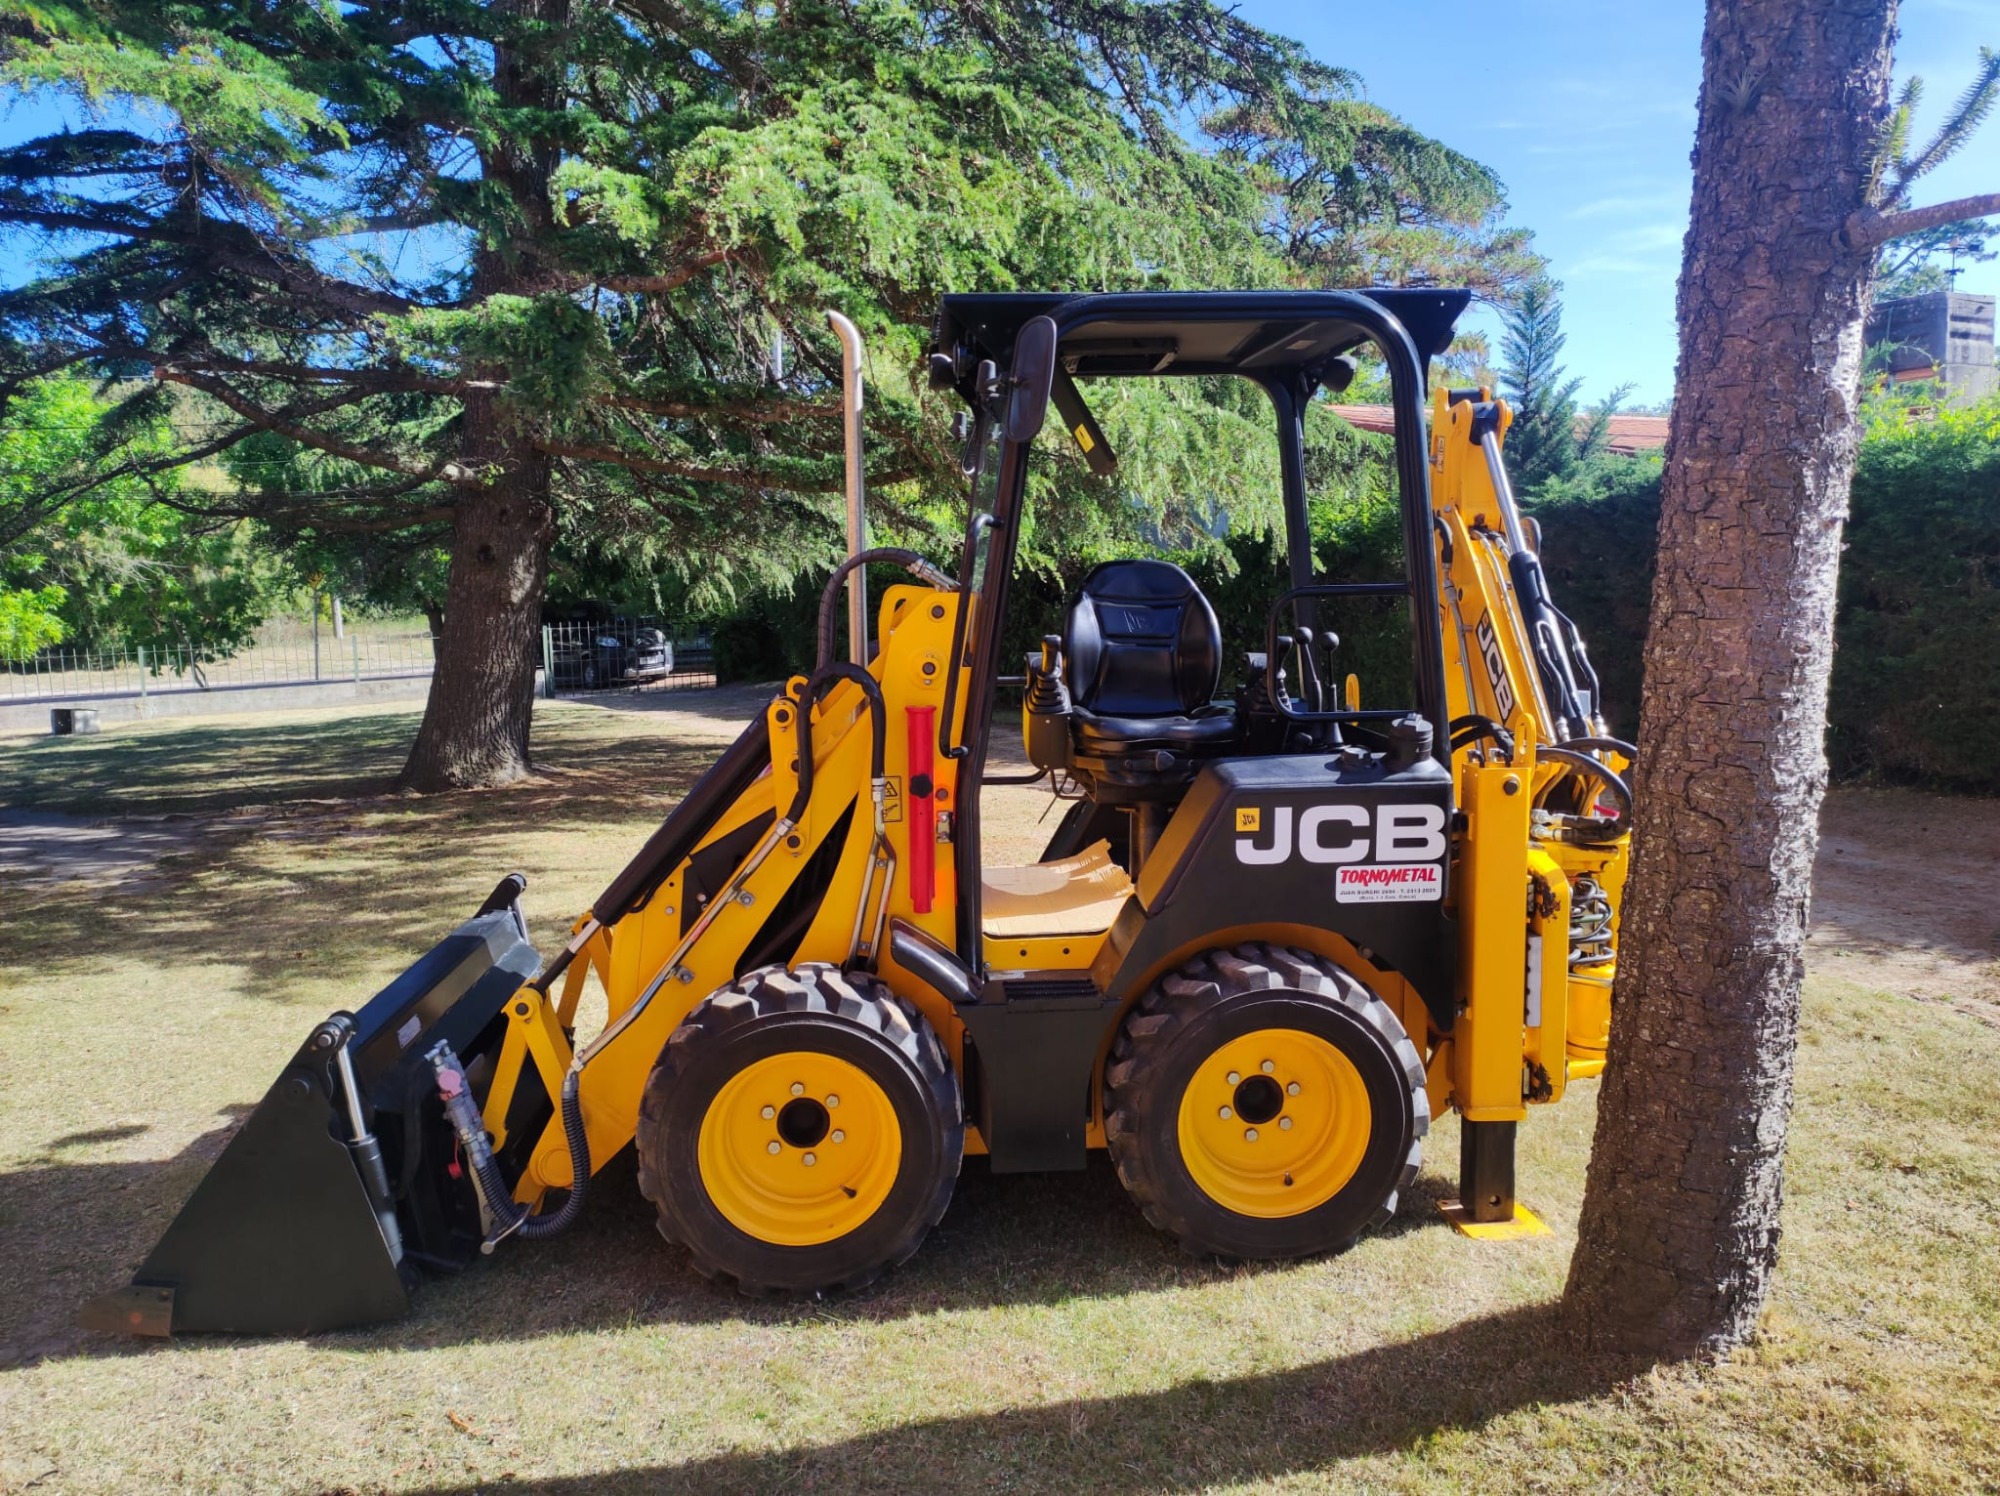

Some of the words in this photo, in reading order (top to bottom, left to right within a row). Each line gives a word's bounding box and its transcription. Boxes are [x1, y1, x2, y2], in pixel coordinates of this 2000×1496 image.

[1477, 623, 1513, 720] JCB
[1235, 804, 1447, 865] JCB
[1340, 868, 1437, 887] TORNOMETAL
